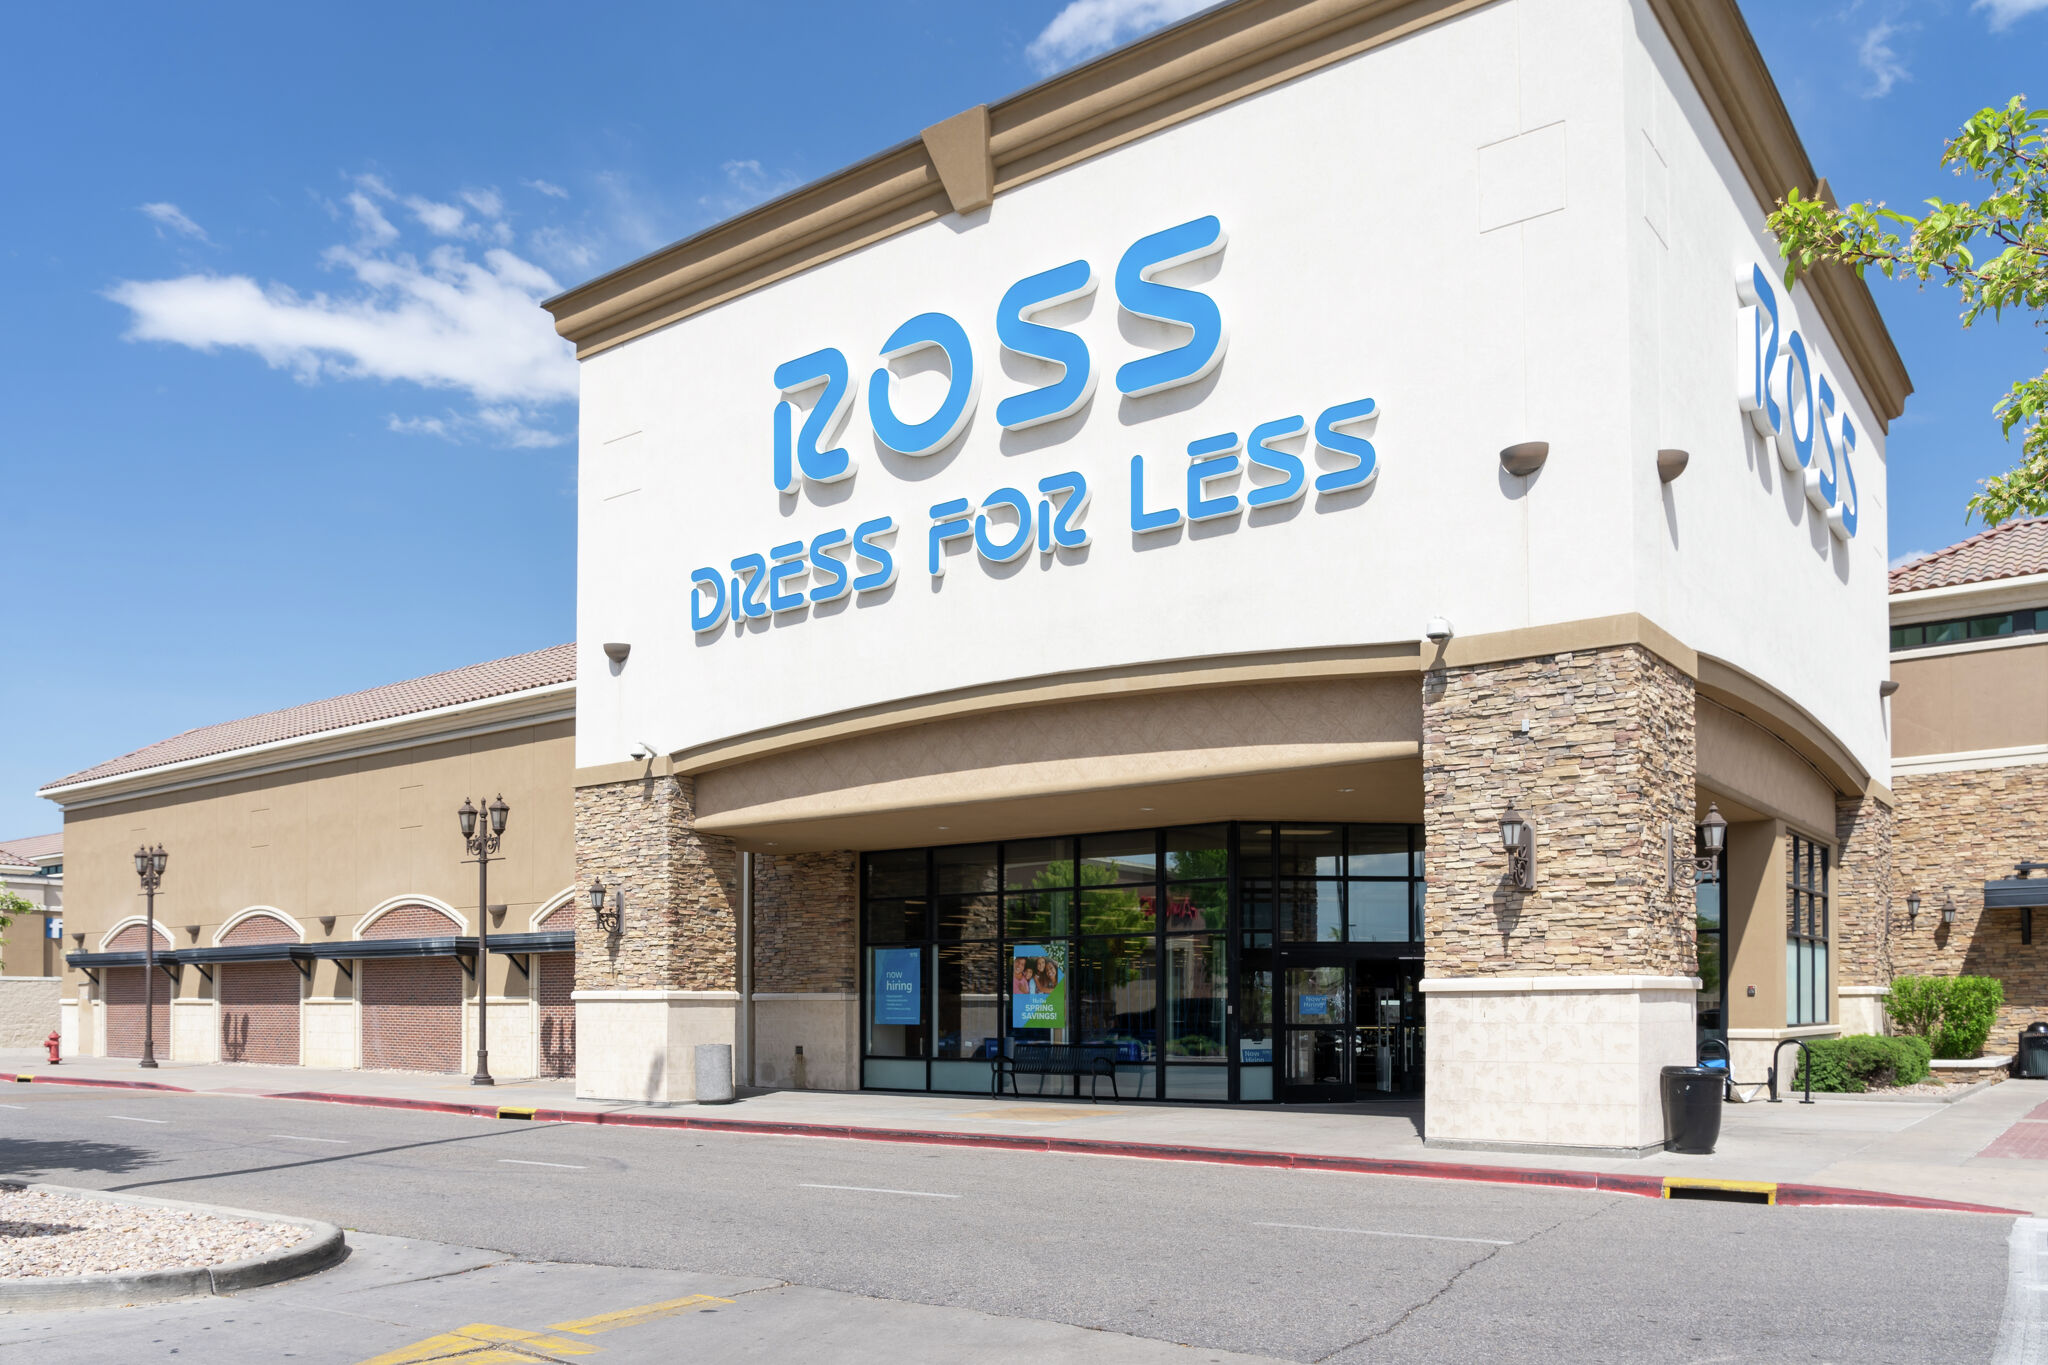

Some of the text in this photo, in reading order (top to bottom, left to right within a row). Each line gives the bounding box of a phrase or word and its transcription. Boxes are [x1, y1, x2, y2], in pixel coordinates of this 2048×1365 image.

[774, 216, 1222, 491] ROSS
[1750, 262, 1858, 539] ROSS
[691, 398, 1376, 631] DRESS FOR LESS
[886, 971, 903, 979] now
[886, 980, 913, 993] hiring
[1025, 1004, 1054, 1012] SPRING
[1021, 1012, 1057, 1020] SAVINGS!
